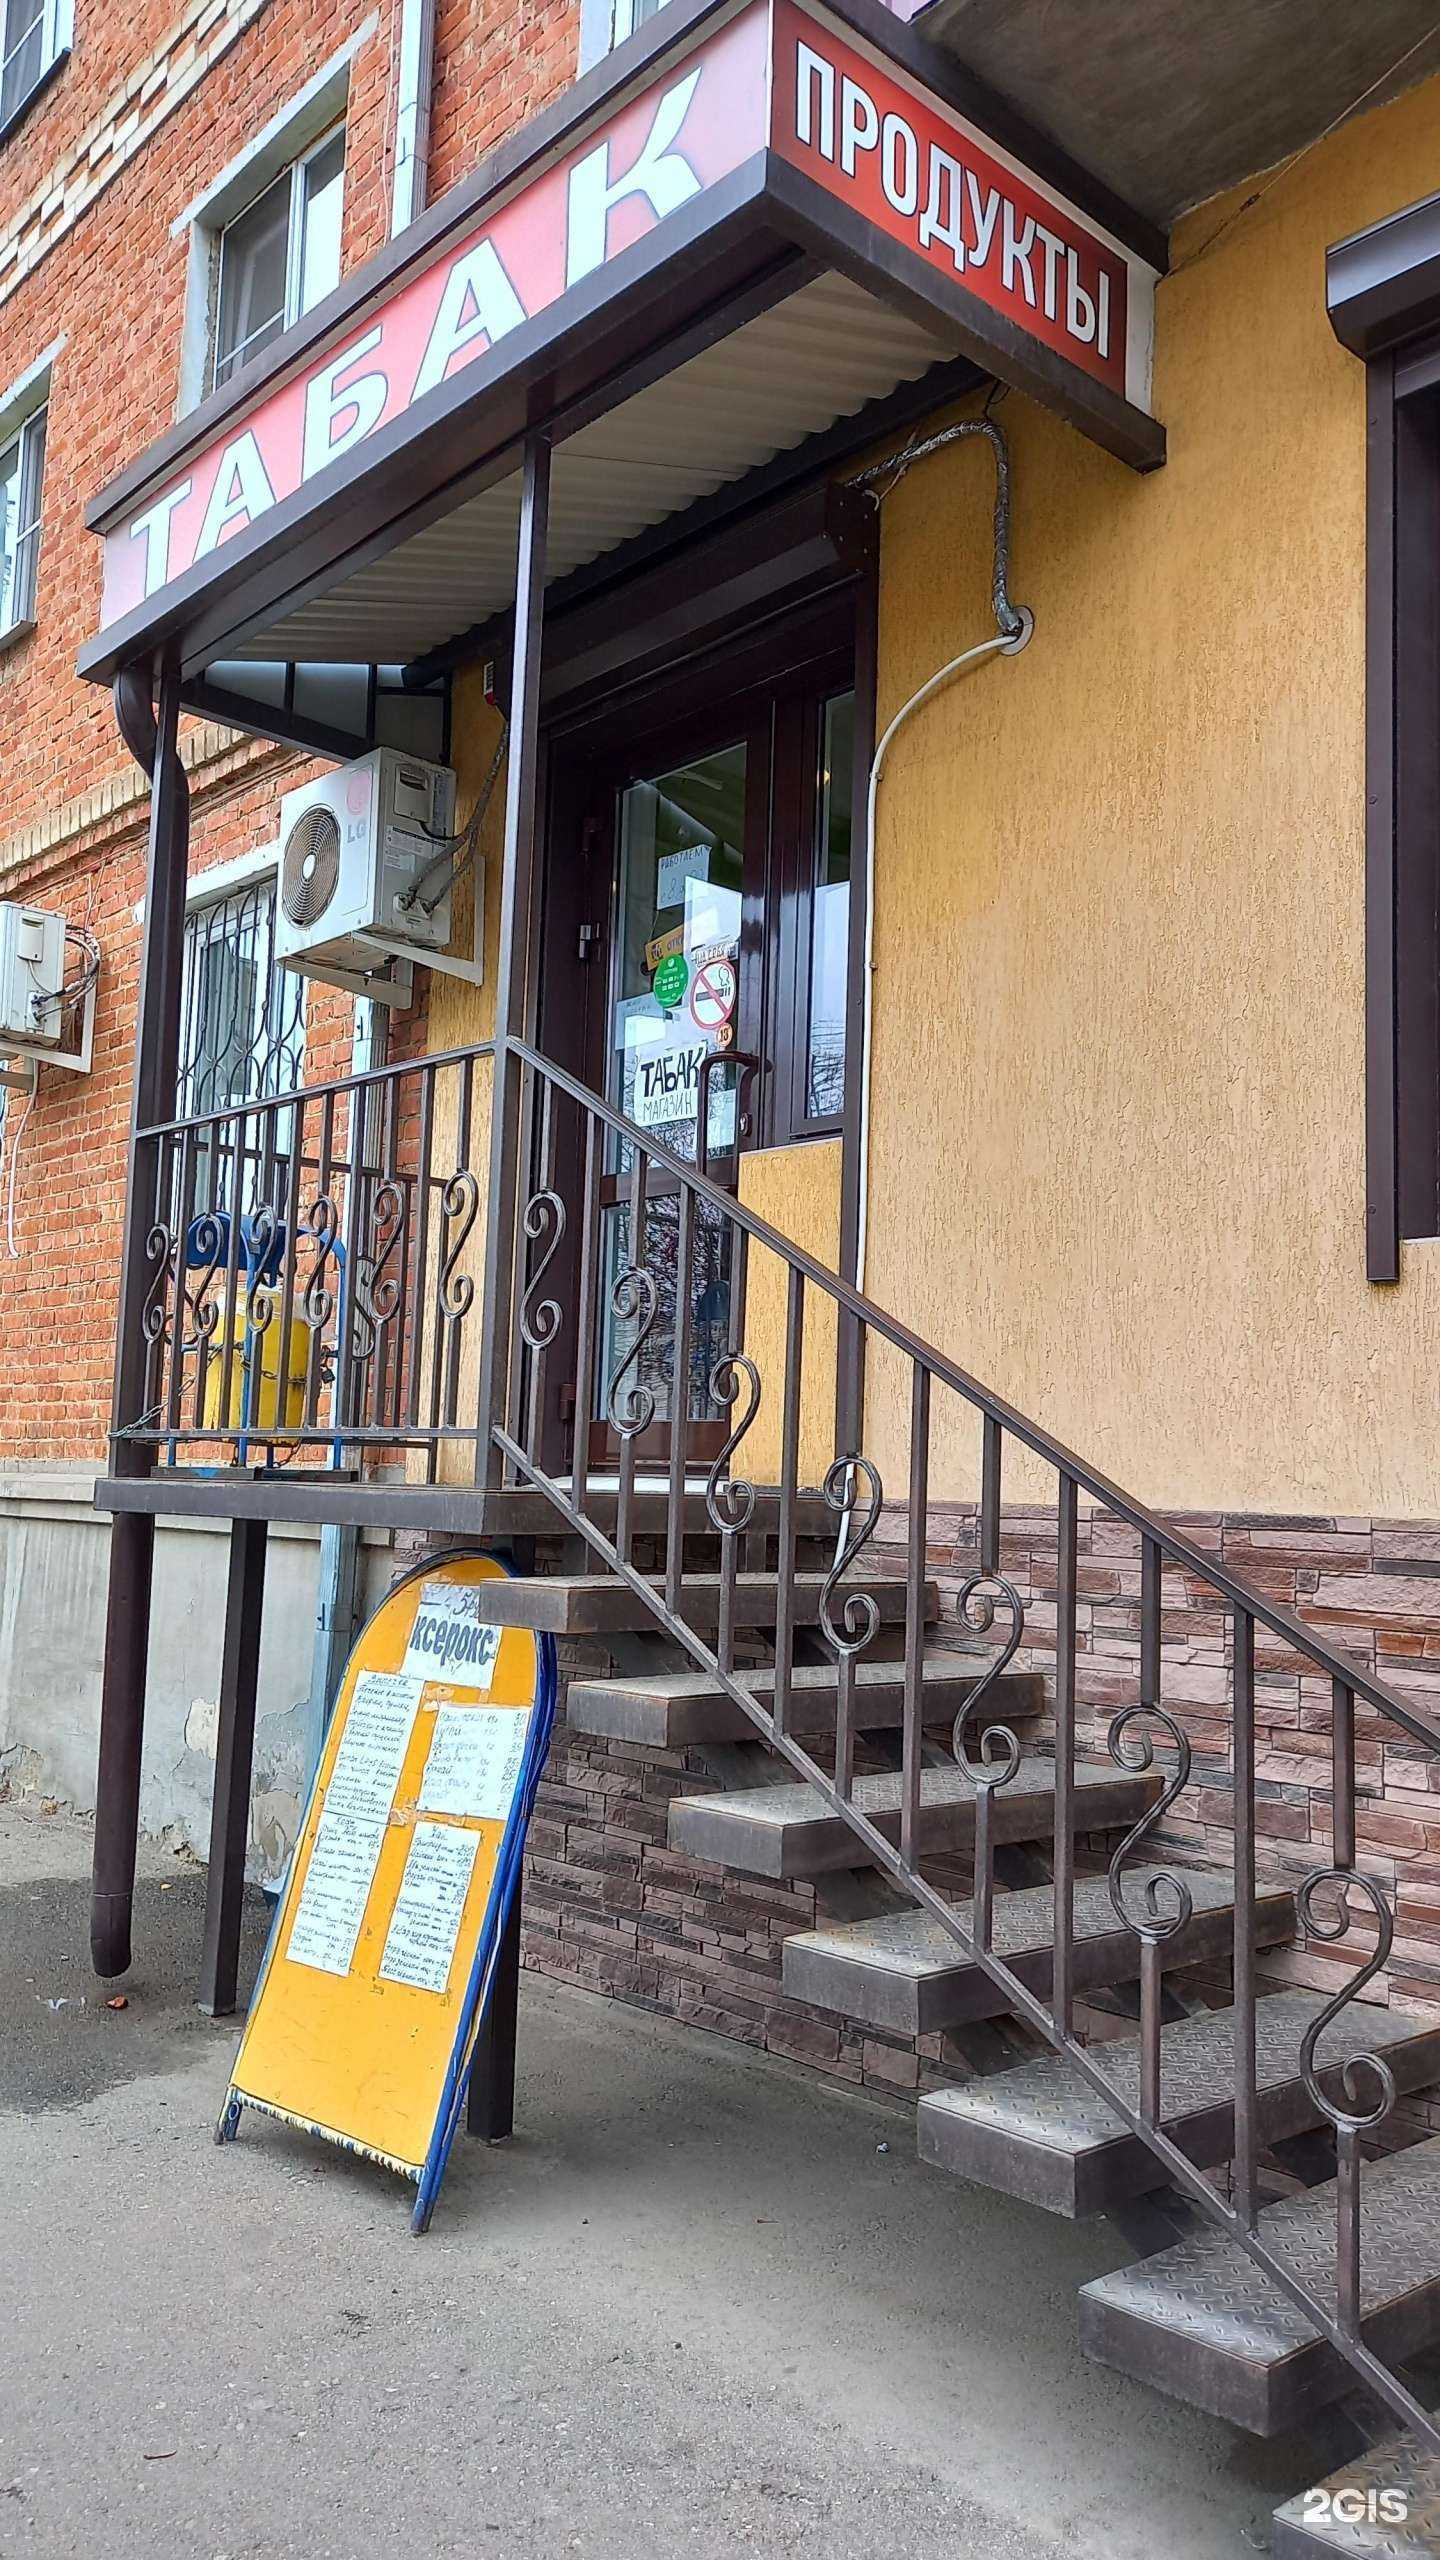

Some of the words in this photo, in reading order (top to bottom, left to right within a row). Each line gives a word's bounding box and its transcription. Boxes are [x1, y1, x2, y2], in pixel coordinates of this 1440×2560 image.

[794, 39, 1111, 361] ПРОДУКТЫ
[128, 65, 705, 600] ТАБАК
[346, 823, 367, 844] LG
[661, 847, 704, 870] РАБОТАЕМ
[640, 1045, 700, 1097] ТАБАК
[642, 1090, 693, 1121] МАГАЗИН
